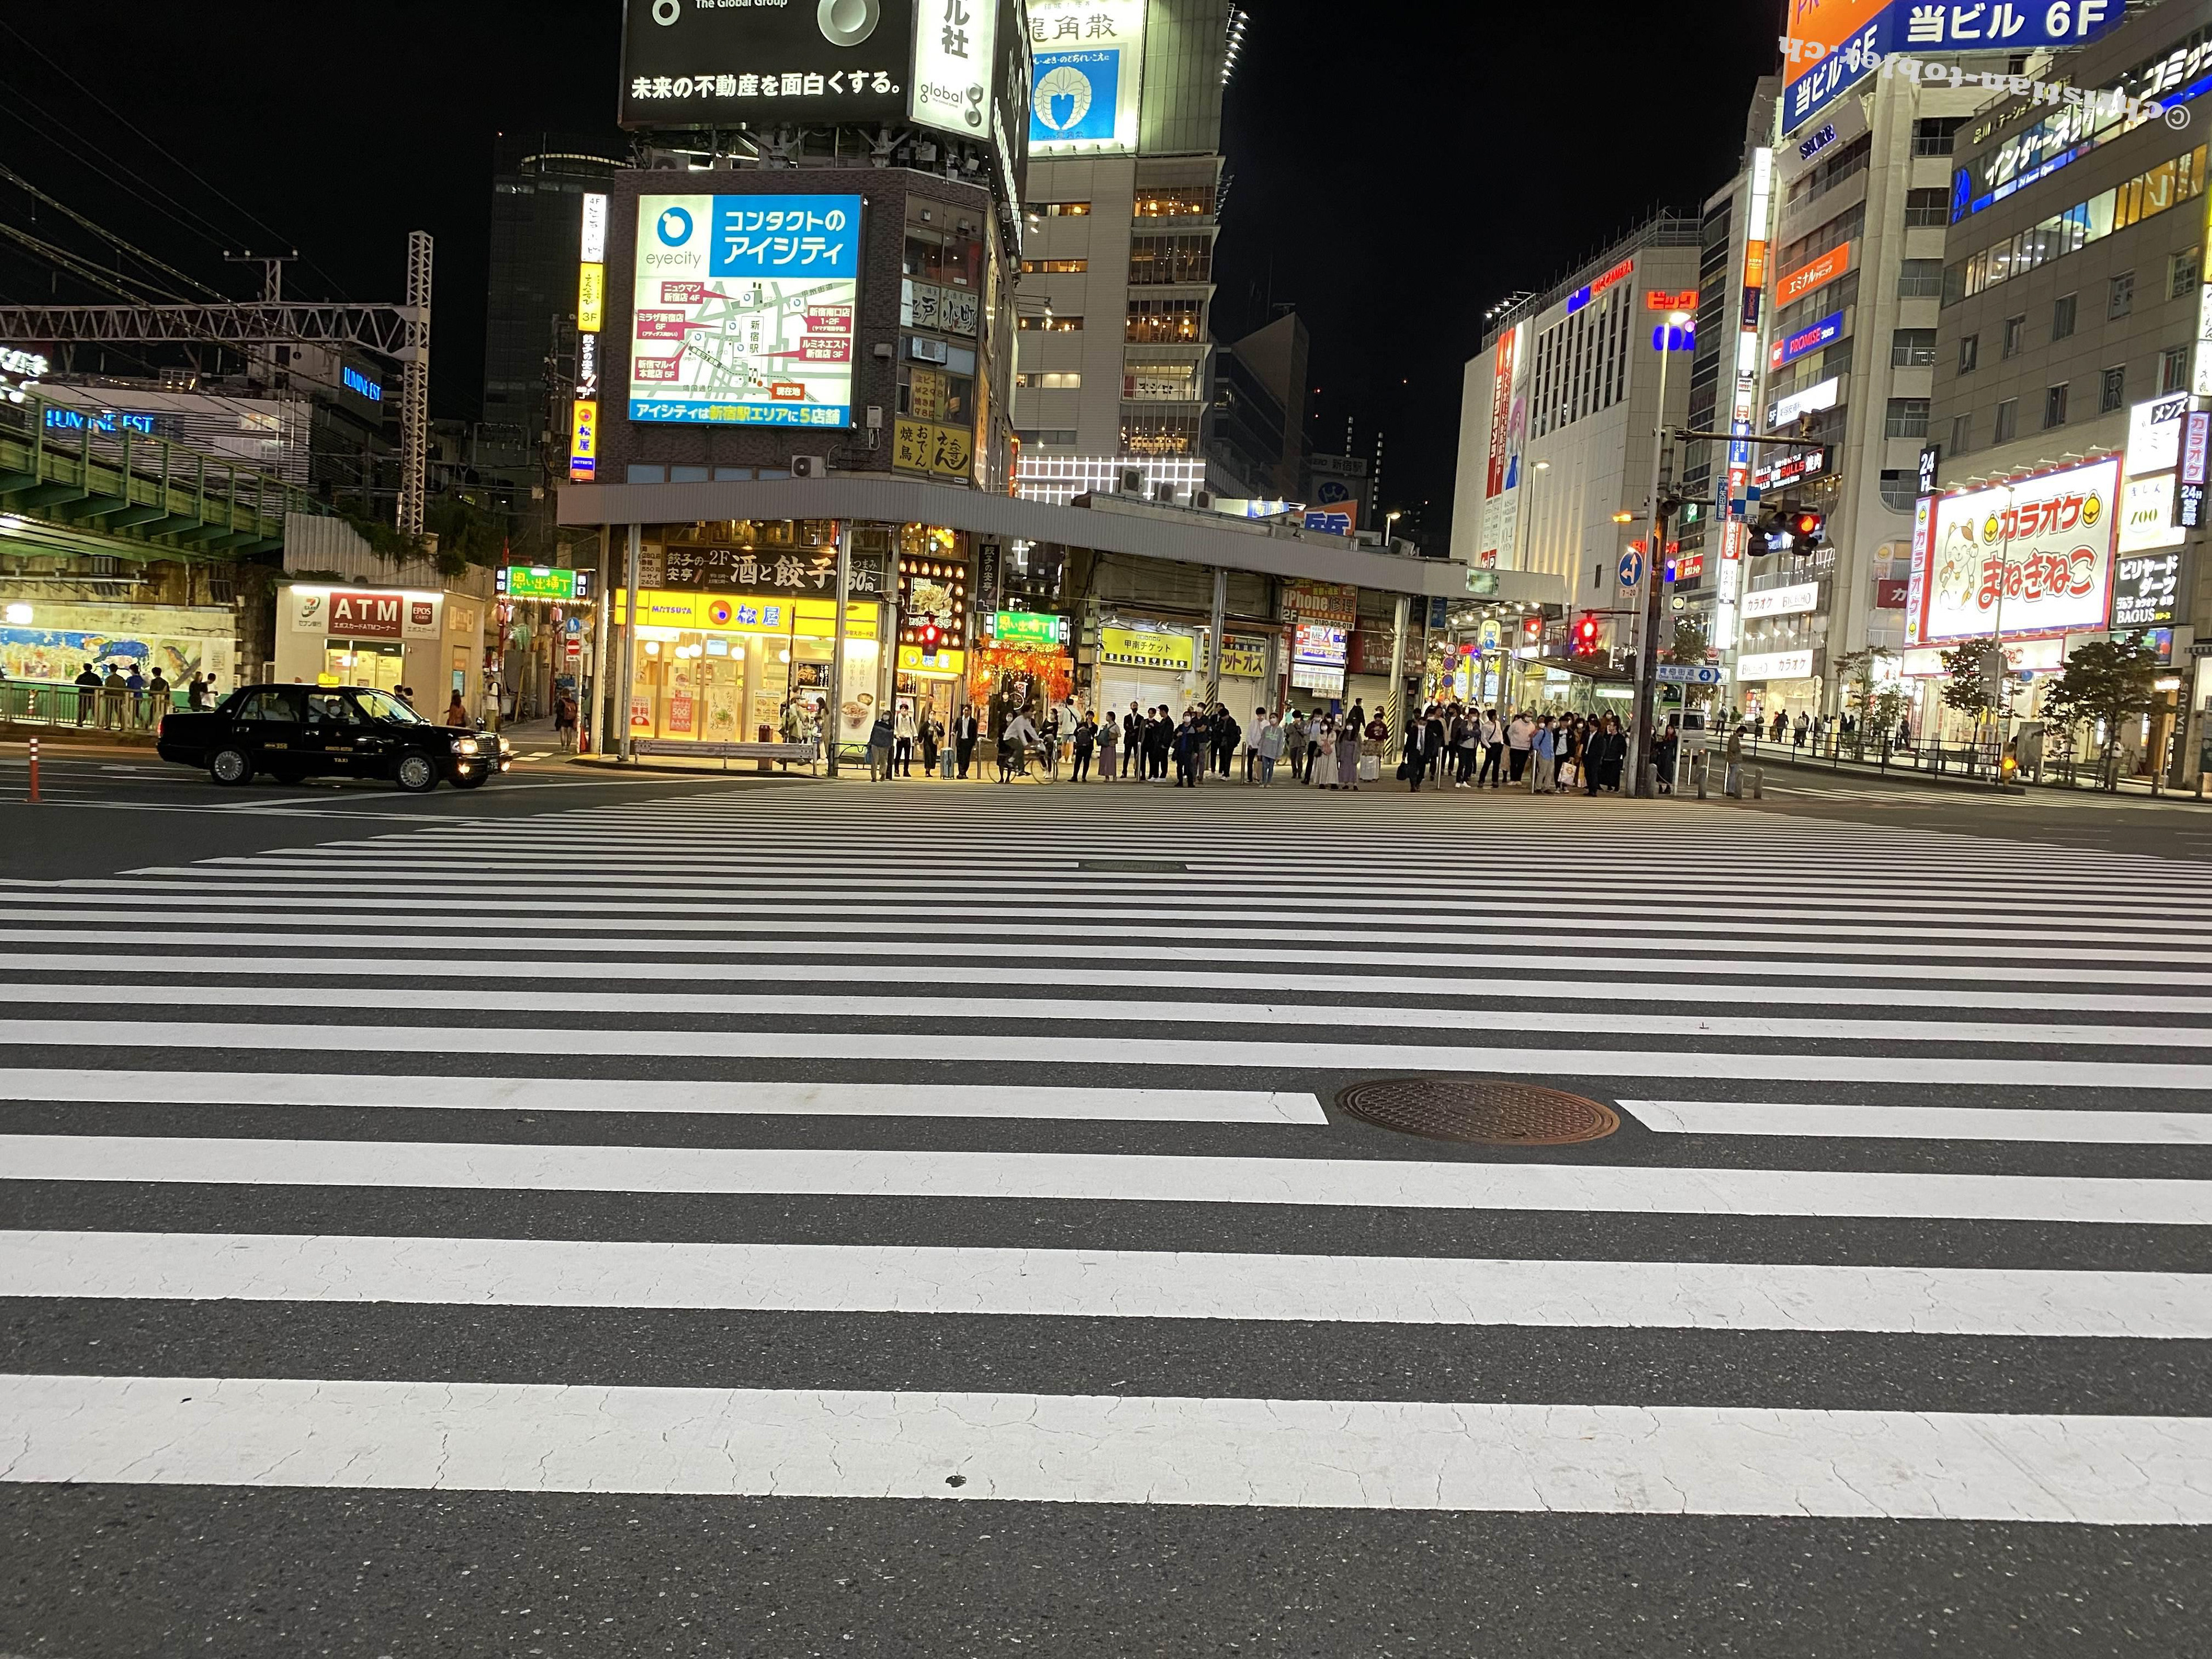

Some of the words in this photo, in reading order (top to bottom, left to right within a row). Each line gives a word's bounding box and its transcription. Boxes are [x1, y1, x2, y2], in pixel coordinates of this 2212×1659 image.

[1027, 13, 1118, 43] 龍角散
[1907, 1, 2026, 43] 当ビル
[2046, 0, 2108, 38] 6F
[1794, 56, 1842, 117] 当ビル
[1849, 24, 1877, 74] 6F
[2141, 40, 2212, 102] コミッ
[631, 70, 900, 100] 未来の不動産を面白くする。
[920, 82, 963, 105] global
[725, 209, 846, 232] コンタクトの
[646, 251, 702, 267] eyecity
[724, 236, 844, 266] アイシティ
[664, 283, 701, 292] ニュウマン
[801, 283, 834, 296] 甲州街道
[664, 293, 688, 302] 新宿店
[689, 294, 701, 302] 4F
[1647, 291, 1698, 309] ビック
[582, 312, 597, 321] 3F
[638, 313, 684, 323] ミラザ新宿店
[809, 308, 851, 317] 新宿南口店
[749, 320, 760, 354] 新宿駅
[801, 339, 849, 349] ルミネエスト
[1789, 327, 1822, 354] PROMISE
[806, 349, 831, 359] 新宿店
[637, 359, 676, 369] 新宿マルイ
[776, 387, 801, 396] 現在地
[636, 403, 841, 425] アイシティは新宿駅エリアに5店舗
[1768, 409, 1777, 422] 5F
[2153, 397, 2188, 424] メンズ
[122, 415, 154, 433] EST
[578, 424, 591, 451] 松屋
[900, 426, 914, 461] 焼鳥
[915, 425, 928, 468] おでん
[2187, 415, 2206, 479] カラオケ
[1332, 460, 1363, 474] 新宿駅
[1781, 460, 1805, 477] BULLS
[1919, 450, 1936, 472] 24
[1921, 475, 1931, 493] H
[2180, 485, 2202, 499] 24H
[1997, 494, 2085, 542] カラオケ
[2180, 499, 2198, 527] 営業
[667, 552, 704, 566] 餃子の
[709, 550, 730, 566] 2F
[666, 567, 694, 581] 安亭
[730, 554, 837, 589] 酒と餃子
[983, 546, 995, 592] 餃子の安亭
[1909, 527, 1927, 616] カラオケ
[2119, 554, 2179, 581] ビリヤード
[512, 571, 571, 592] 思い出横丁
[1976, 544, 2099, 613] まねきねこ
[2138, 575, 2177, 597] ダーツ
[334, 598, 397, 622] ATM
[412, 607, 431, 615] EPOS
[652, 605, 692, 615] MATSUYA
[1747, 596, 1774, 611] カラオケ
[736, 603, 781, 627] 松屋
[1282, 608, 1297, 621] 2F
[2116, 607, 2156, 624] BAGUS
[334, 623, 397, 631] エポスカードATMコーナー
[1315, 619, 1353, 630] 0120-905-019
[1124, 639, 1171, 654] 甲南チケット
[1660, 667, 1694, 676] 青梅街道
[1778, 658, 1806, 671] カラオケ
[1702, 671, 1708, 680] 4
[631, 706, 649, 716] 無料
